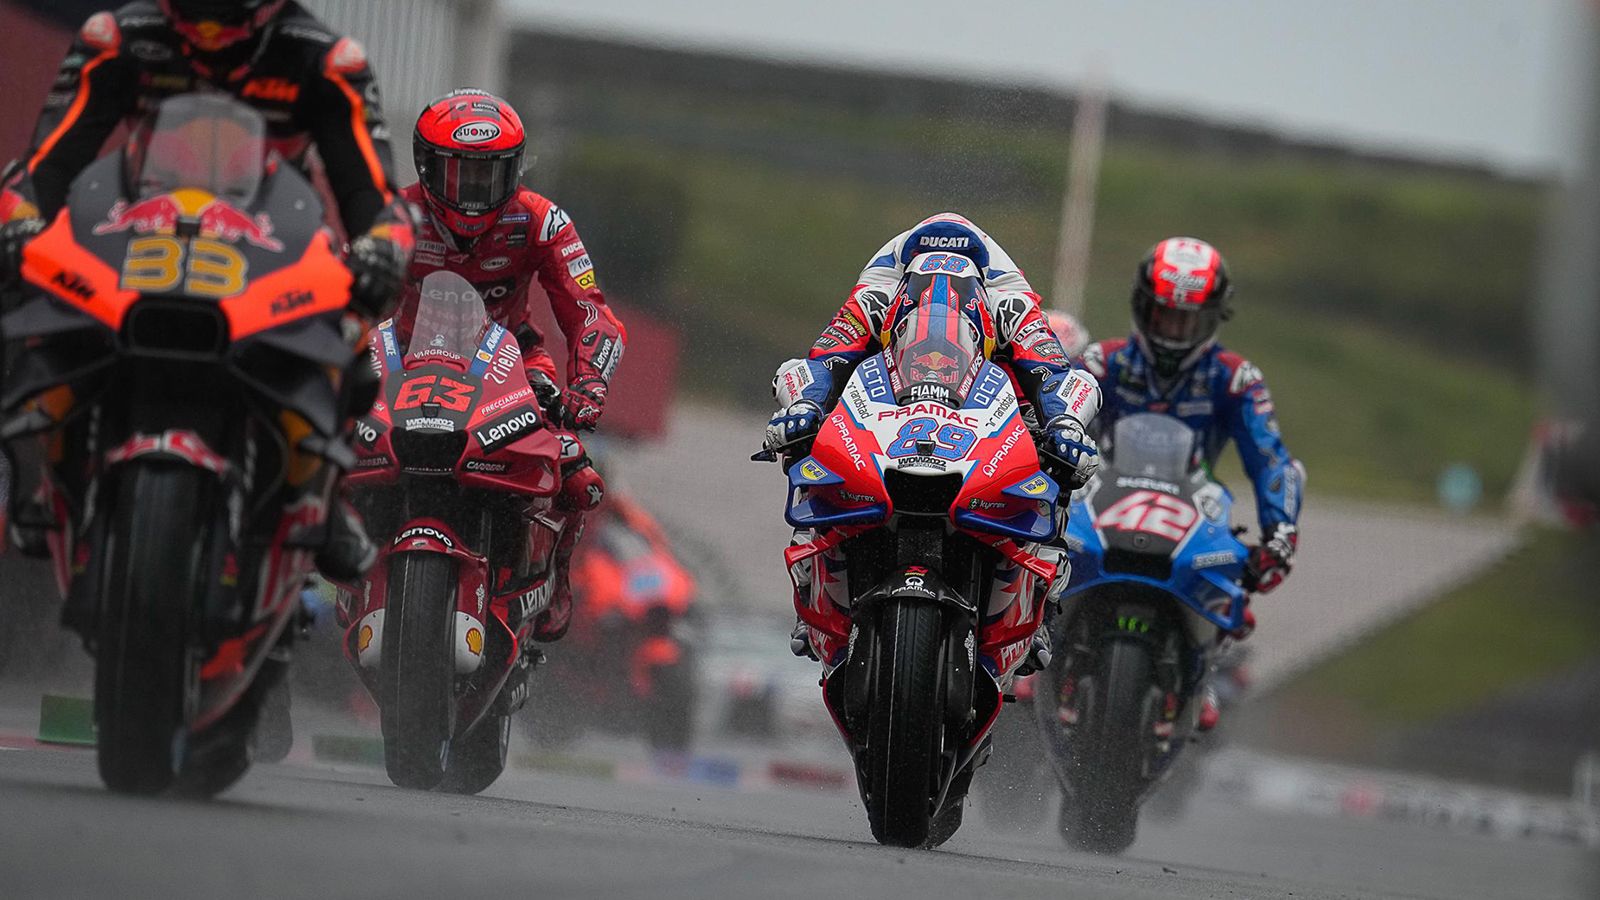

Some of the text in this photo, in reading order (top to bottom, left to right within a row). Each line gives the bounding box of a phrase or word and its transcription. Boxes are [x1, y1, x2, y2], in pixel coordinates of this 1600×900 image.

[457, 127, 497, 138] SUOMY
[919, 236, 970, 248] DUCATI
[120, 237, 248, 295] 33
[919, 253, 969, 273] 68
[51, 270, 96, 300] KTM
[270, 286, 315, 314] KTM
[493, 344, 521, 379] riello
[393, 375, 476, 412] 63
[862, 358, 888, 398] OCTO
[911, 384, 949, 398] FIAMM
[973, 366, 1005, 405] OCTO
[481, 388, 533, 415] FRECCIAROSSA
[850, 389, 874, 420] randstad
[993, 391, 1016, 420] randstad
[1071, 383, 1093, 414] PRAMAC
[477, 411, 537, 447] Lenovo
[877, 403, 978, 429] PRAMAC
[836, 420, 867, 471] PRAMAC
[886, 416, 978, 462] 89
[989, 424, 1027, 469] PRAMAC
[1093, 490, 1198, 543] 42
[394, 526, 453, 549] Lenovo
[891, 585, 936, 598] PRAMAC
